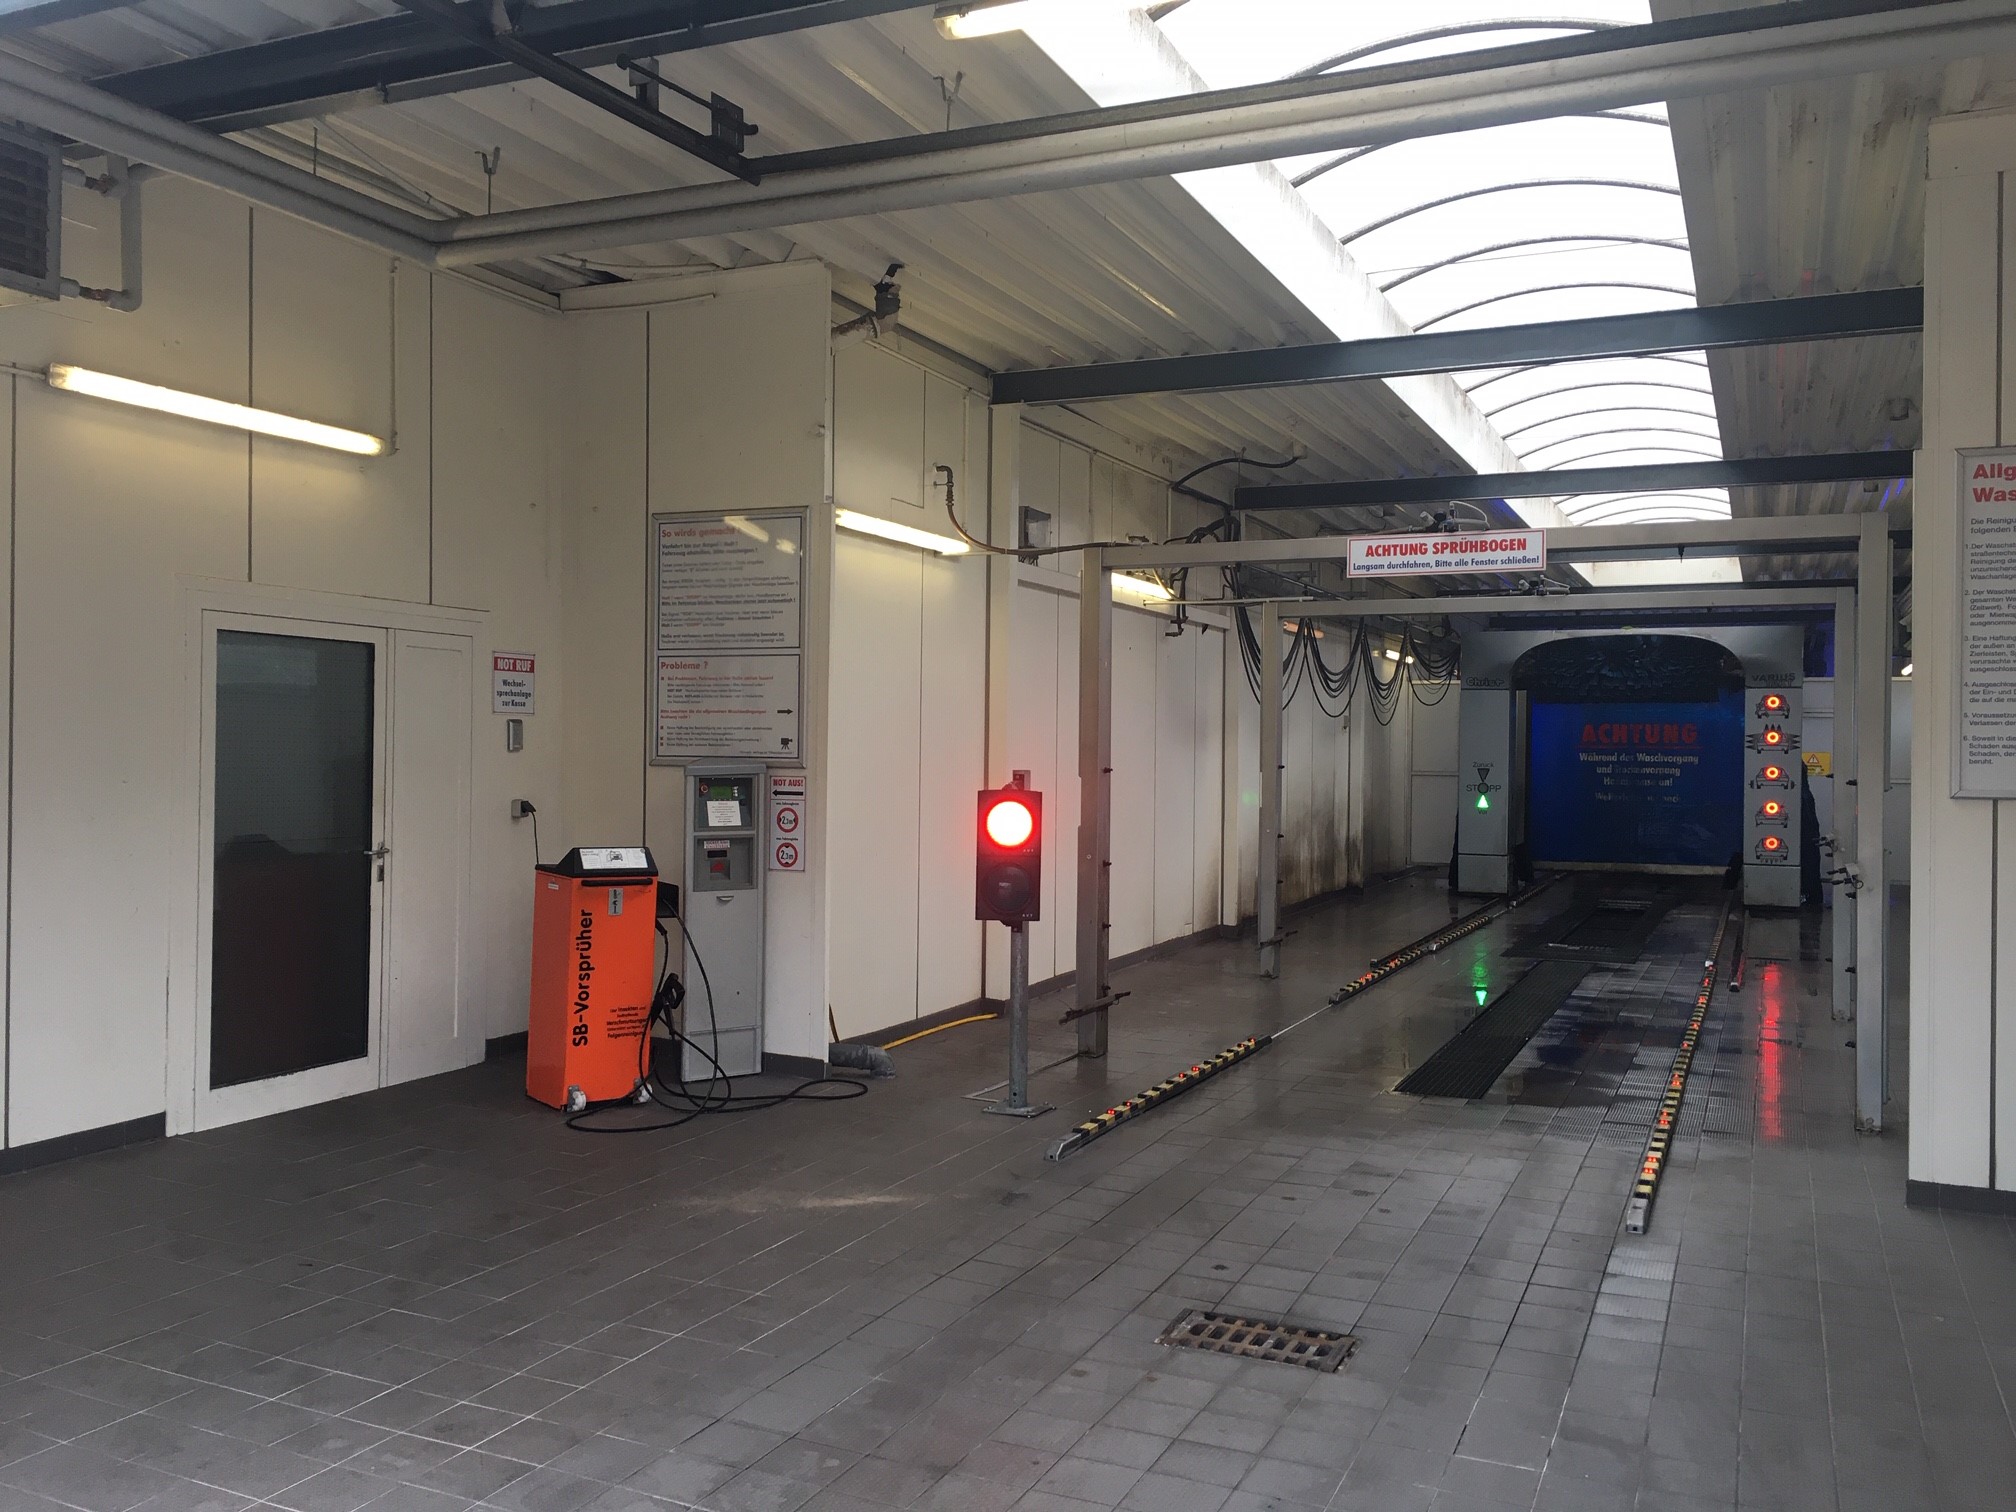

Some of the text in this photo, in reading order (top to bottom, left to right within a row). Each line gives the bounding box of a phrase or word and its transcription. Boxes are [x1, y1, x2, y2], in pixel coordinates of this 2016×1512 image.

[1973, 463, 2016, 481] Allg
[662, 528, 671, 538] So
[674, 527, 696, 537] wirds
[1971, 526, 2011, 535] folgenden
[1365, 537, 1527, 558] ACHTUNG SPRÜHBOGEN
[1353, 555, 1540, 572] Langsam durchfahren, Bitte alle Fenster schließen!
[497, 658, 532, 672] NOT RUF
[660, 661, 709, 671] Probleme ?
[502, 679, 526, 687] Wechsel-
[496, 689, 532, 699] sprechanlage
[511, 699, 526, 707] Kasse
[1581, 722, 1698, 745] ACHTUNG
[1579, 752, 1618, 762] Während
[1596, 764, 1613, 774] und
[773, 779, 804, 787] NOT AUS!
[572, 908, 596, 1047] SB-Vorsprüher
